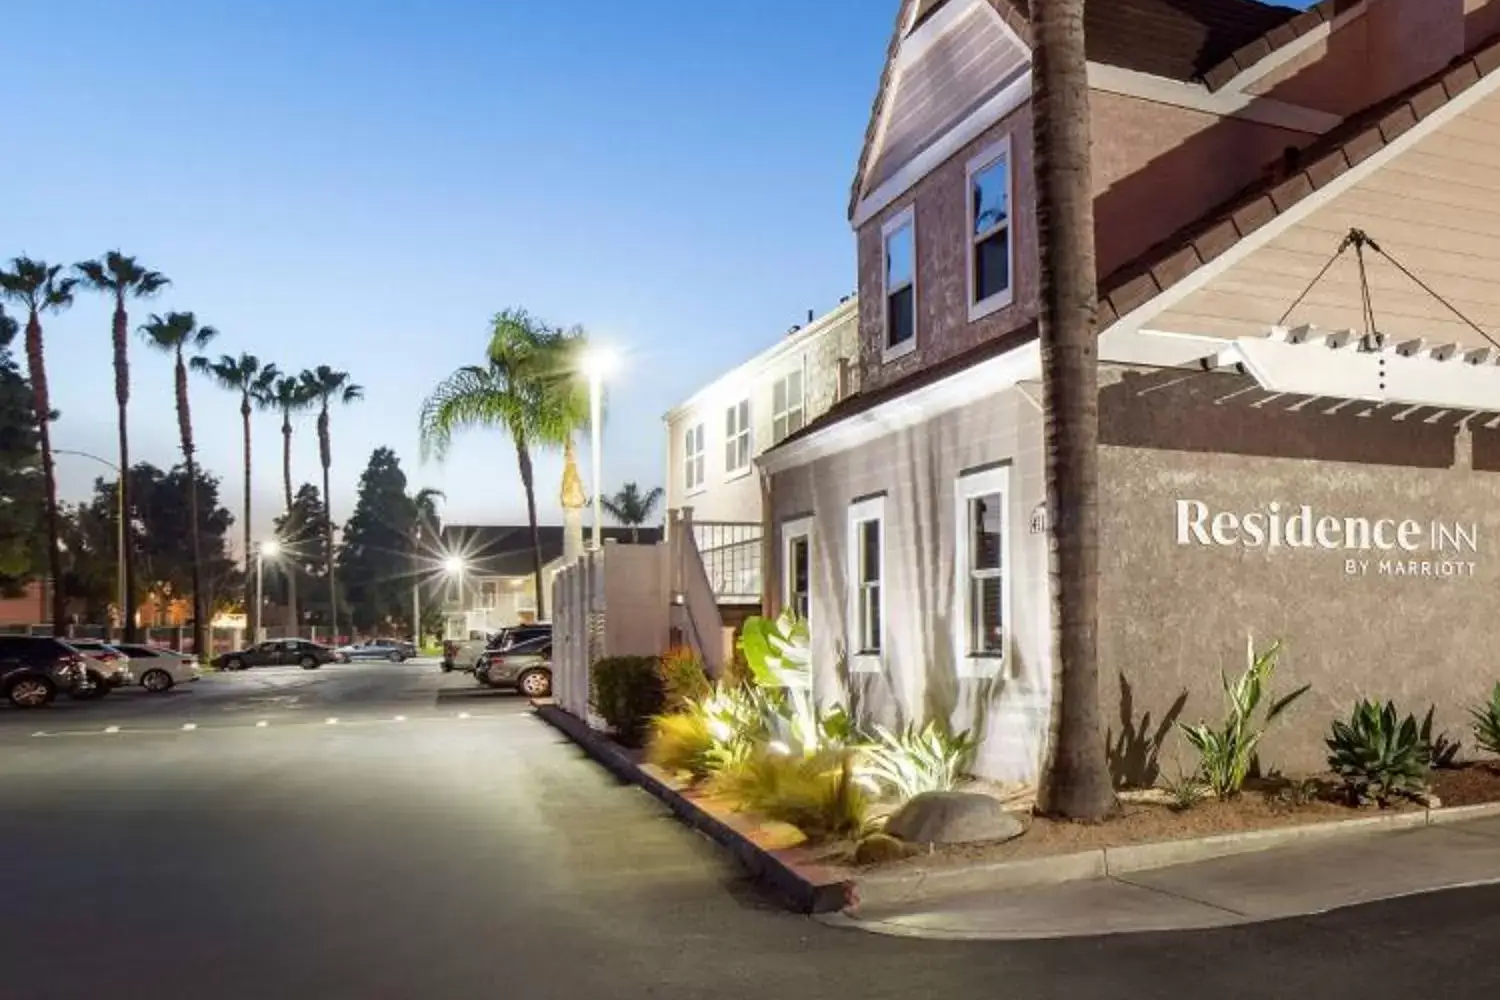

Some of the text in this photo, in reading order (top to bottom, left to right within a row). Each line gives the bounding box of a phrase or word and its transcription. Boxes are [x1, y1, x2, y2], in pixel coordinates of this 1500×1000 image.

[1175, 498, 1477, 552] Residence INN
[1345, 559, 1476, 577] BY MARRIOTT
